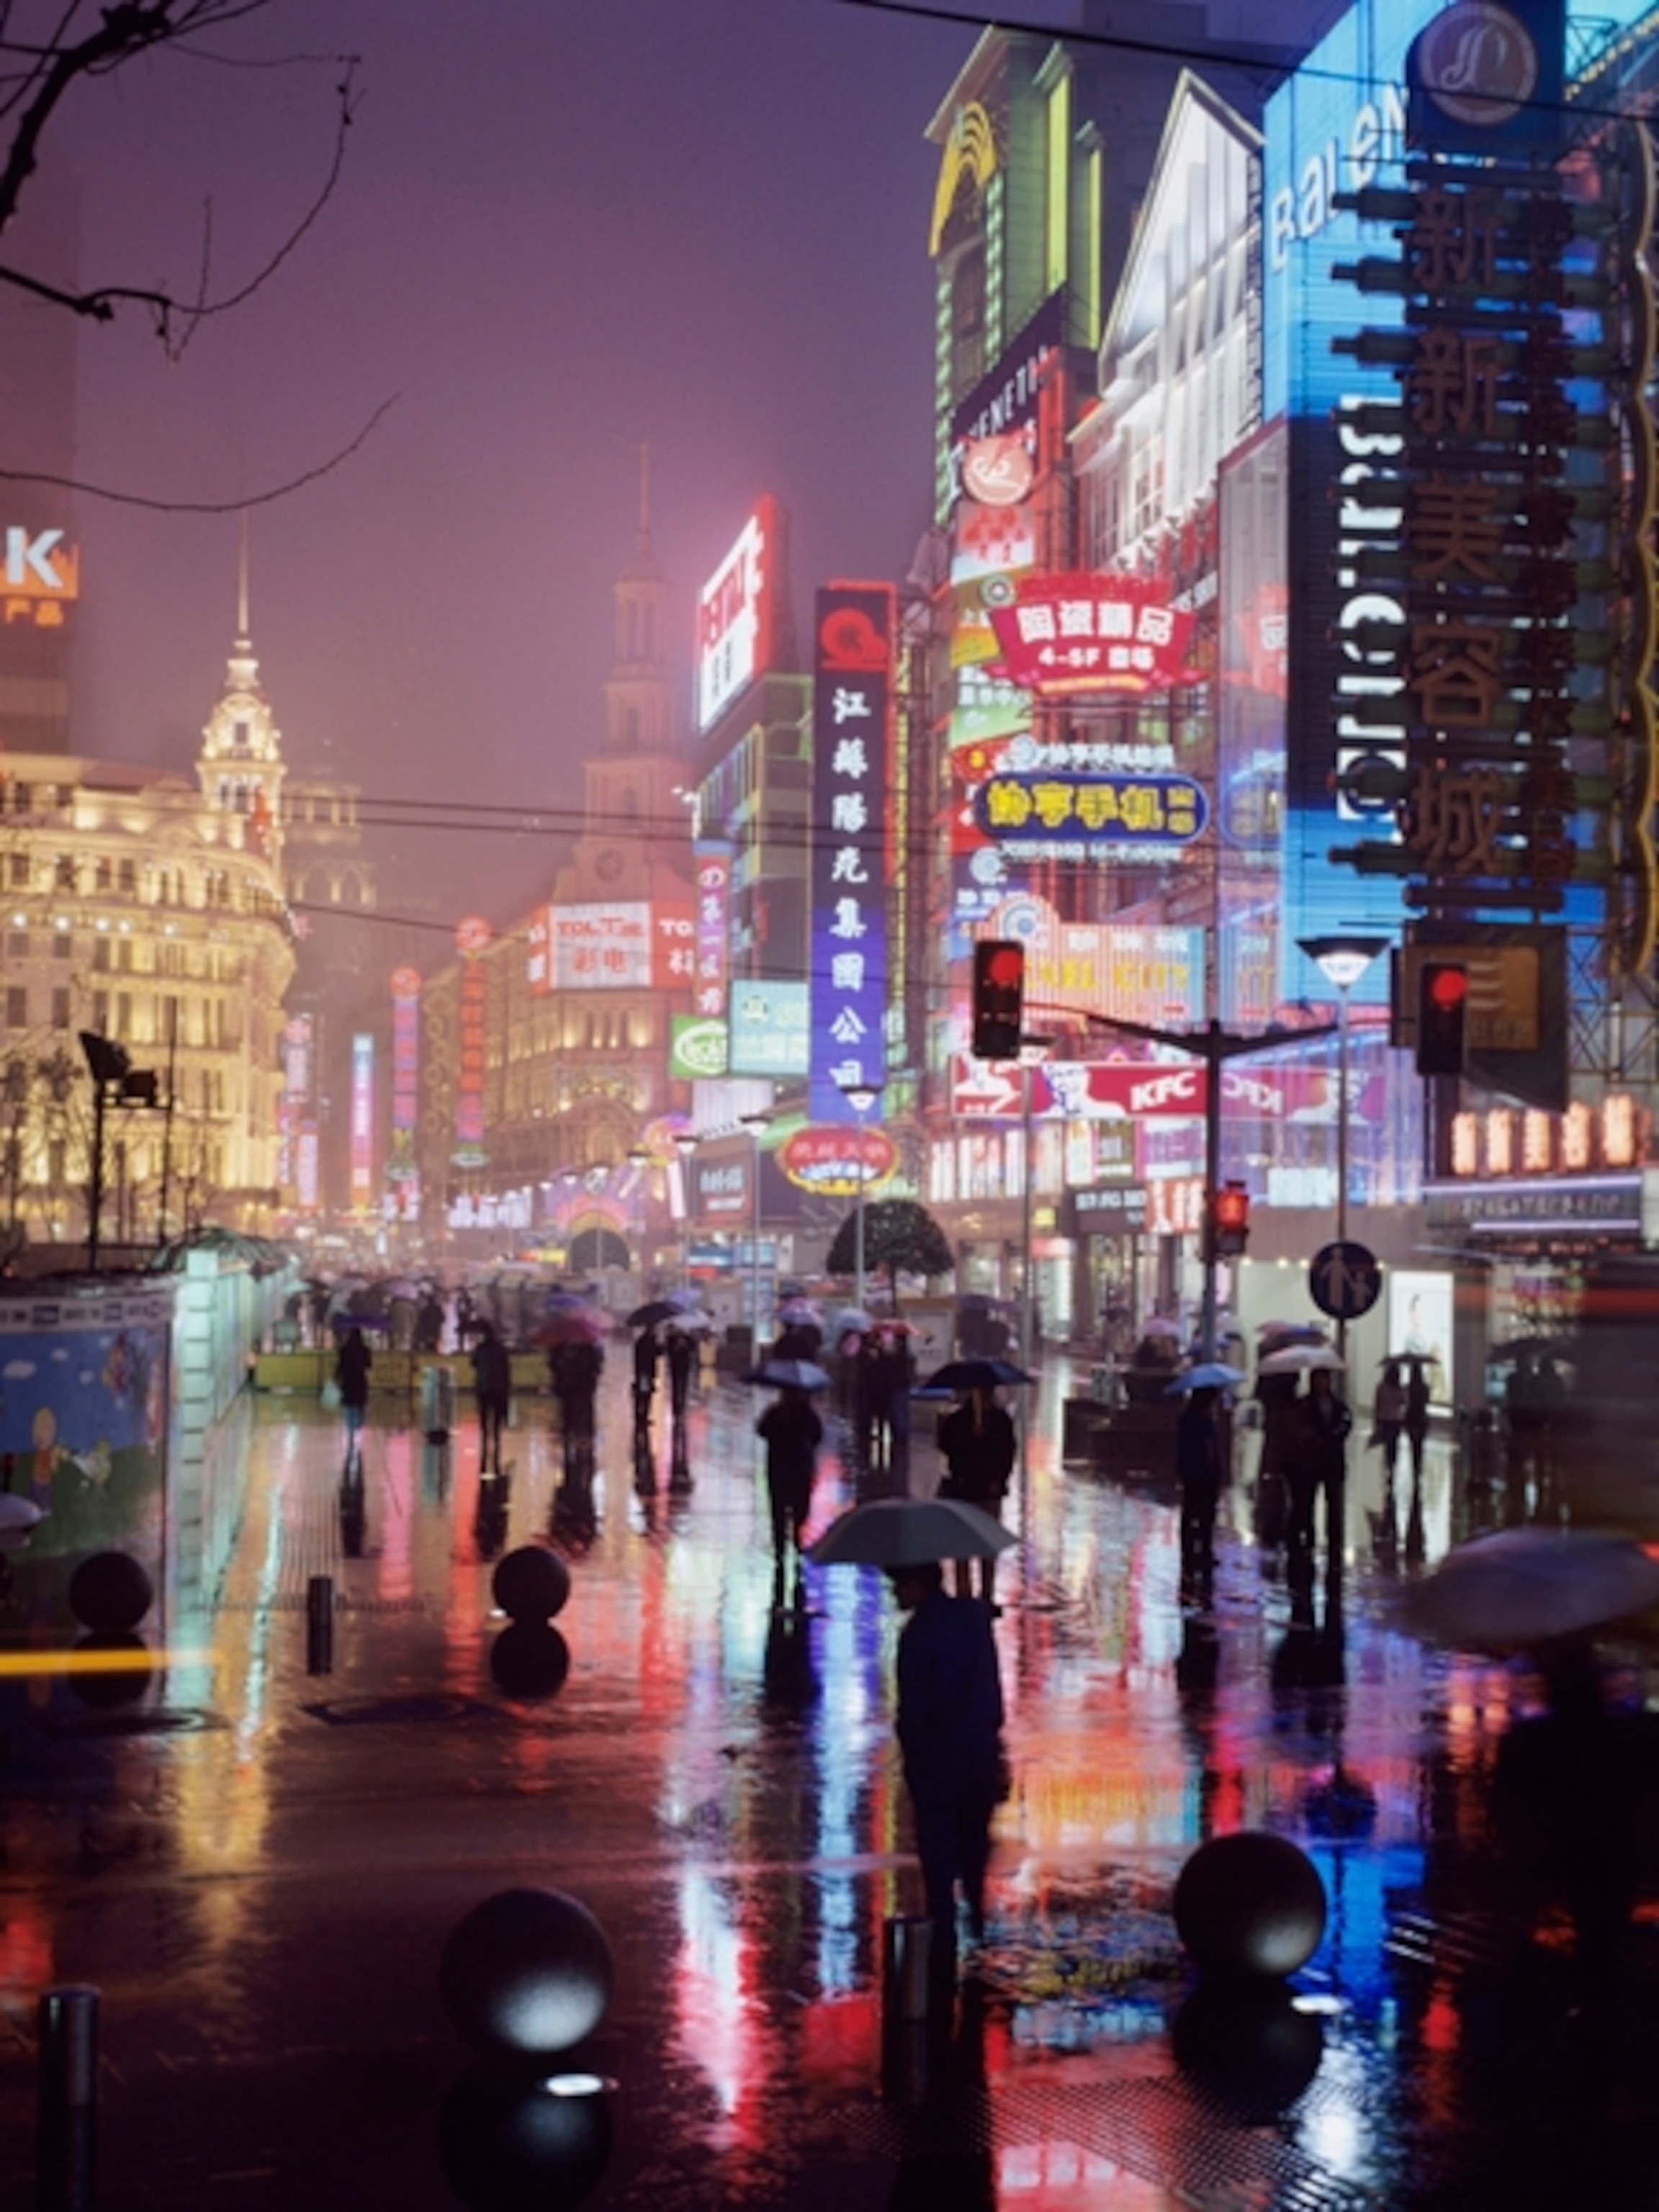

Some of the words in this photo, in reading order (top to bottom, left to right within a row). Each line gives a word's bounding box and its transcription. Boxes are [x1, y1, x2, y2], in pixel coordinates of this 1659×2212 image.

[6, 526, 65, 589] K
[1411, 184, 1505, 875] 新新美容城
[1130, 1071, 1196, 1111] KFC
